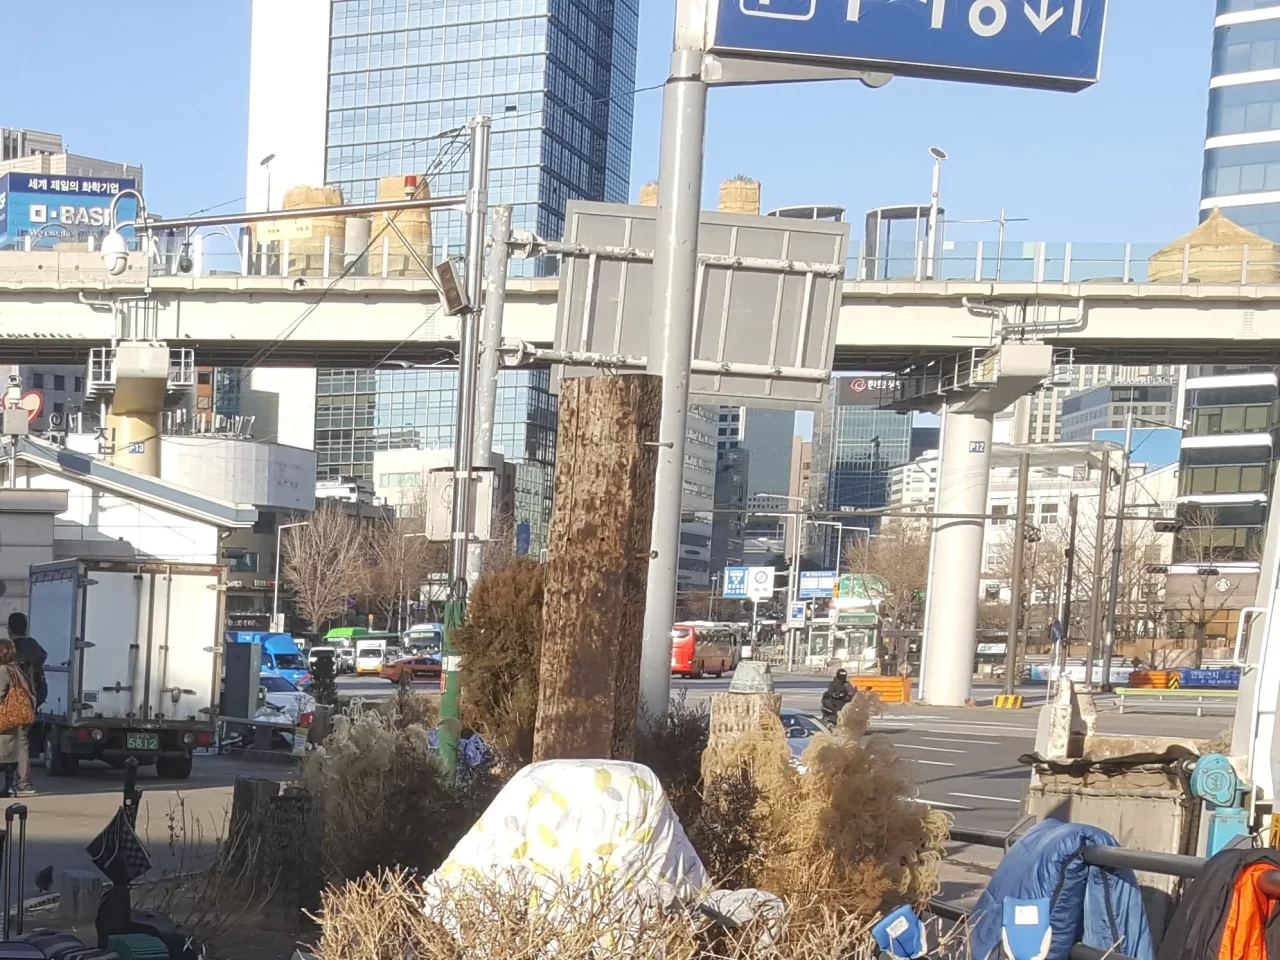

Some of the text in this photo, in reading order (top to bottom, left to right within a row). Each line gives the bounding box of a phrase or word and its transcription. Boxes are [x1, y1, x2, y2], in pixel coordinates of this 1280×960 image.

[28, 178, 119, 194] 세계 제일의 화학기업
[129, 443, 144, 453] P13
[970, 442, 984, 451] P12
[128, 738, 157, 749] 5812
